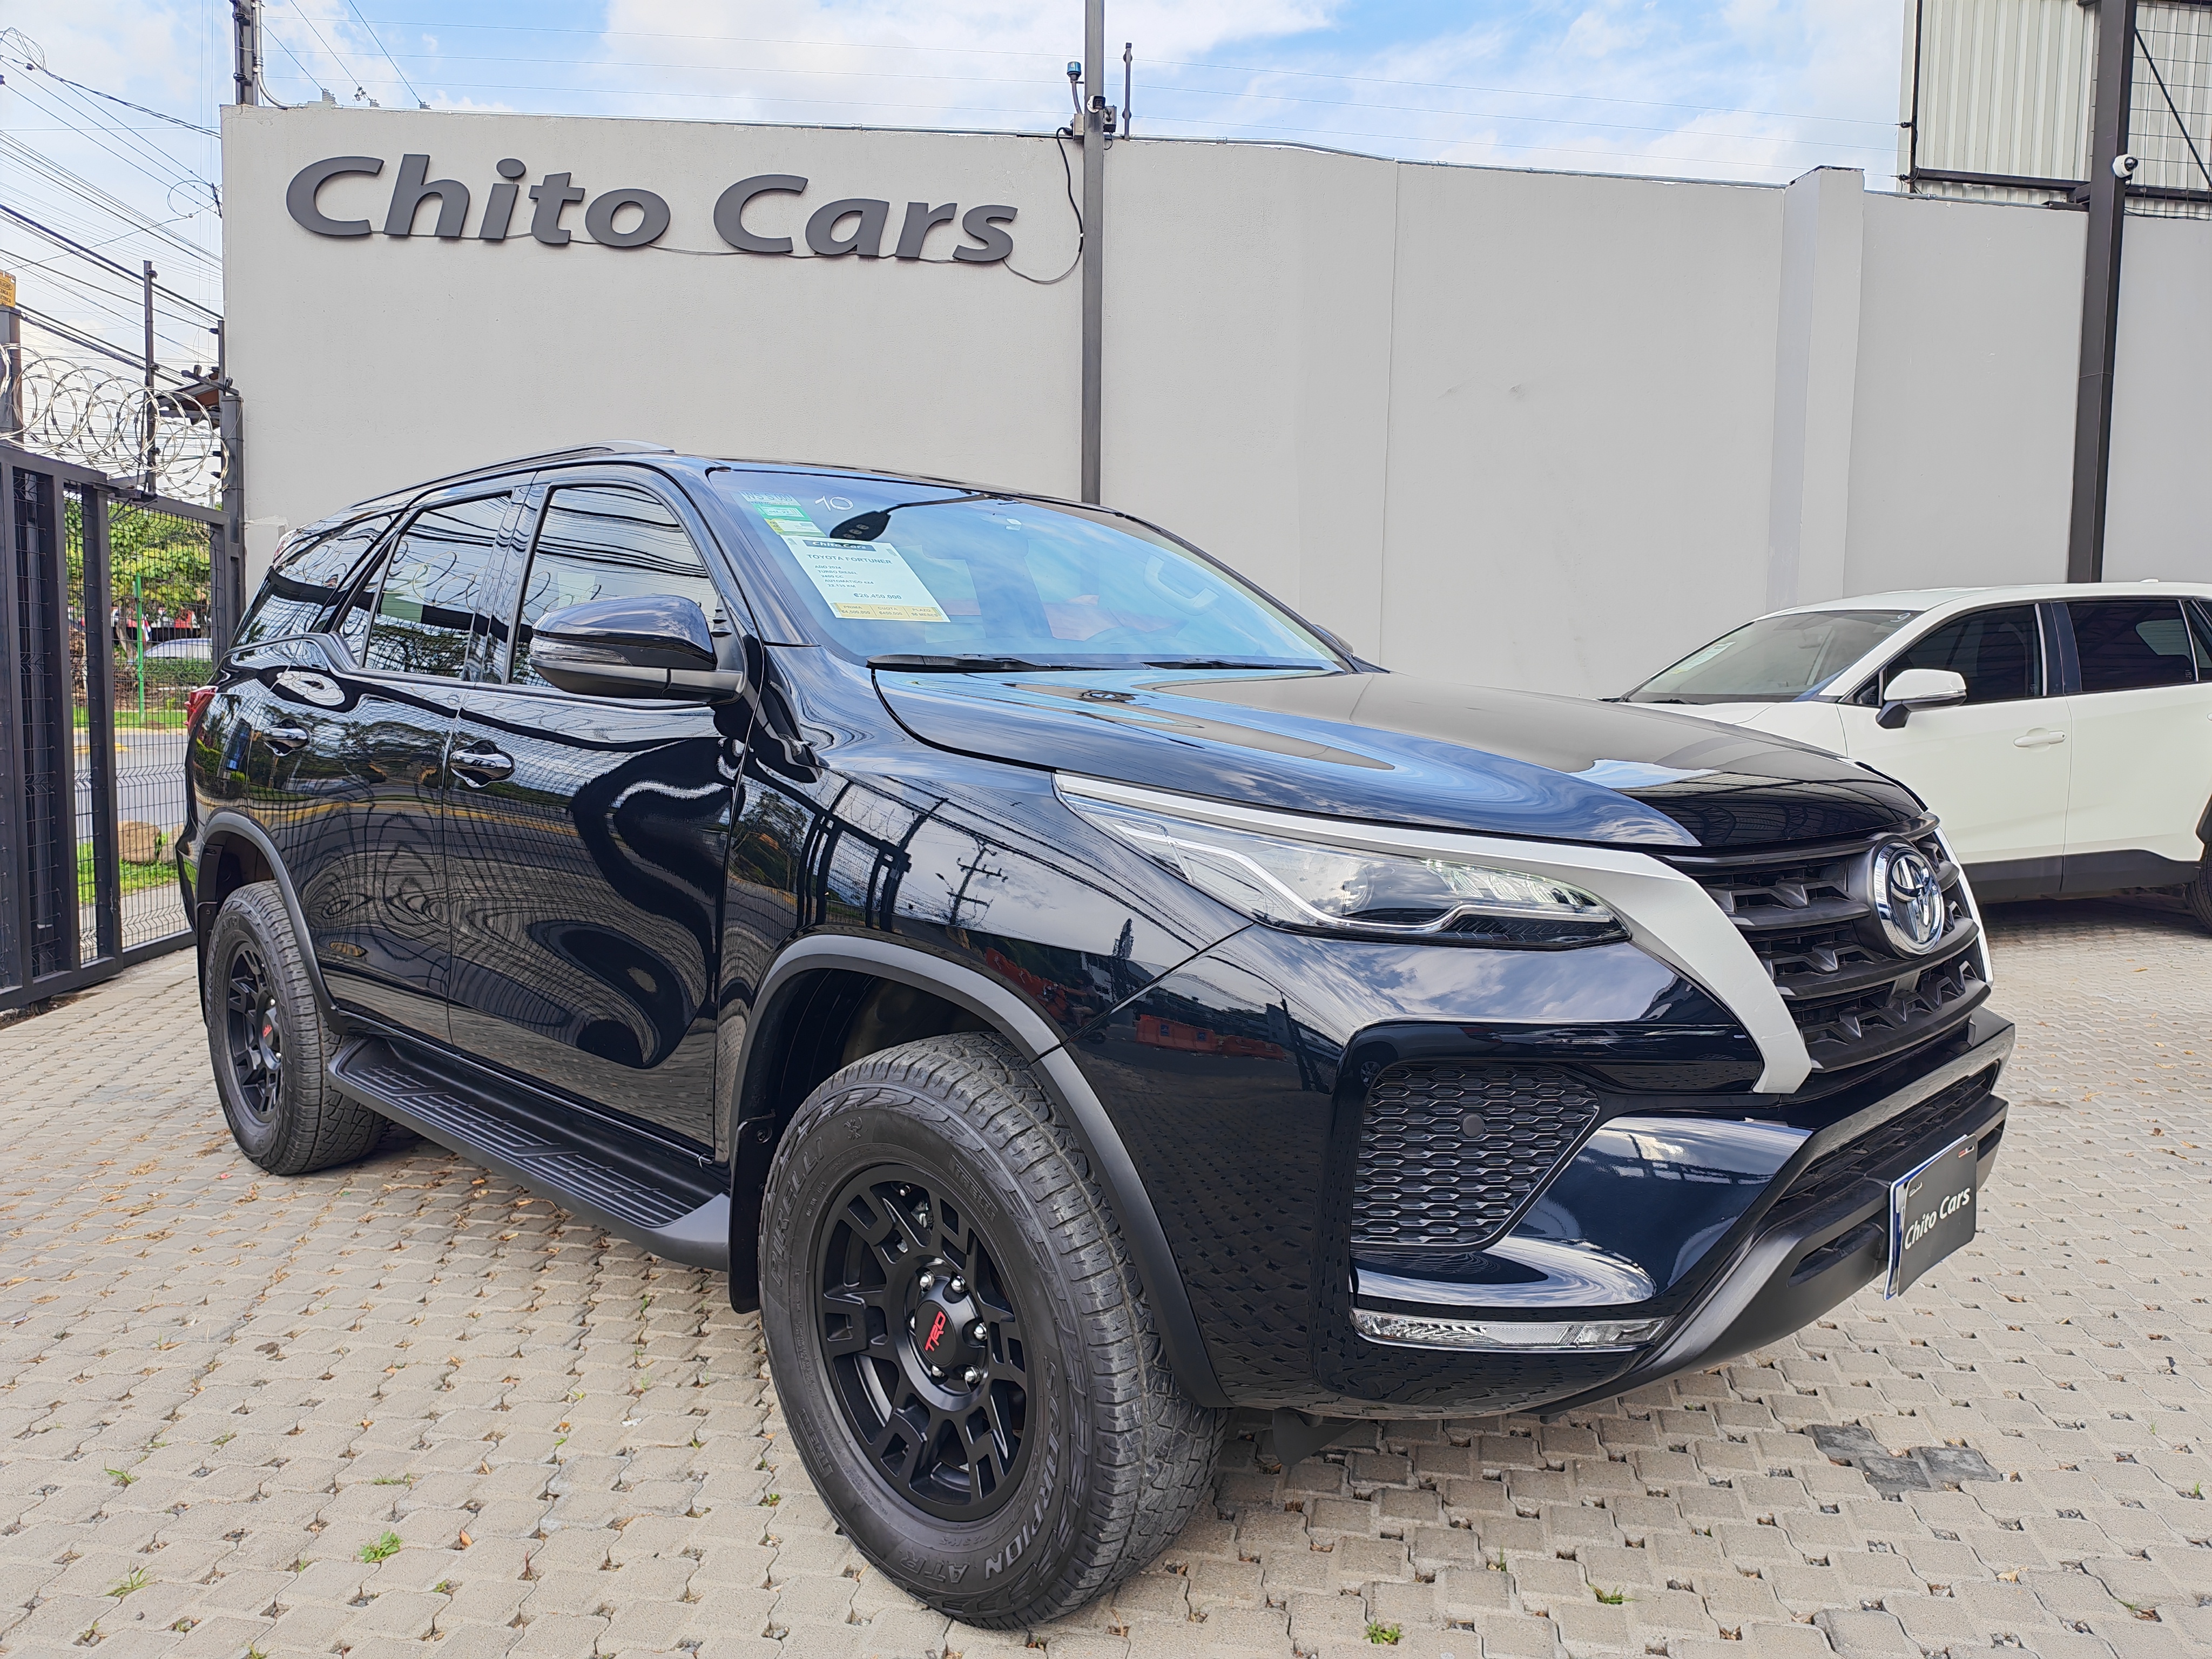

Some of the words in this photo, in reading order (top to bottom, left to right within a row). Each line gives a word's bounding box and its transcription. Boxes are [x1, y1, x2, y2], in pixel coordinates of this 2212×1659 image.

[286, 153, 671, 248] Chito
[713, 173, 1019, 262] Cars
[814, 495, 853, 511] 10
[771, 1136, 825, 1287] PIRELLI
[1904, 1211, 1937, 1250] Chito
[1939, 1188, 1971, 1219] Cars
[925, 1311, 946, 1351] TRD
[984, 1355, 1060, 1580] SCORPION
